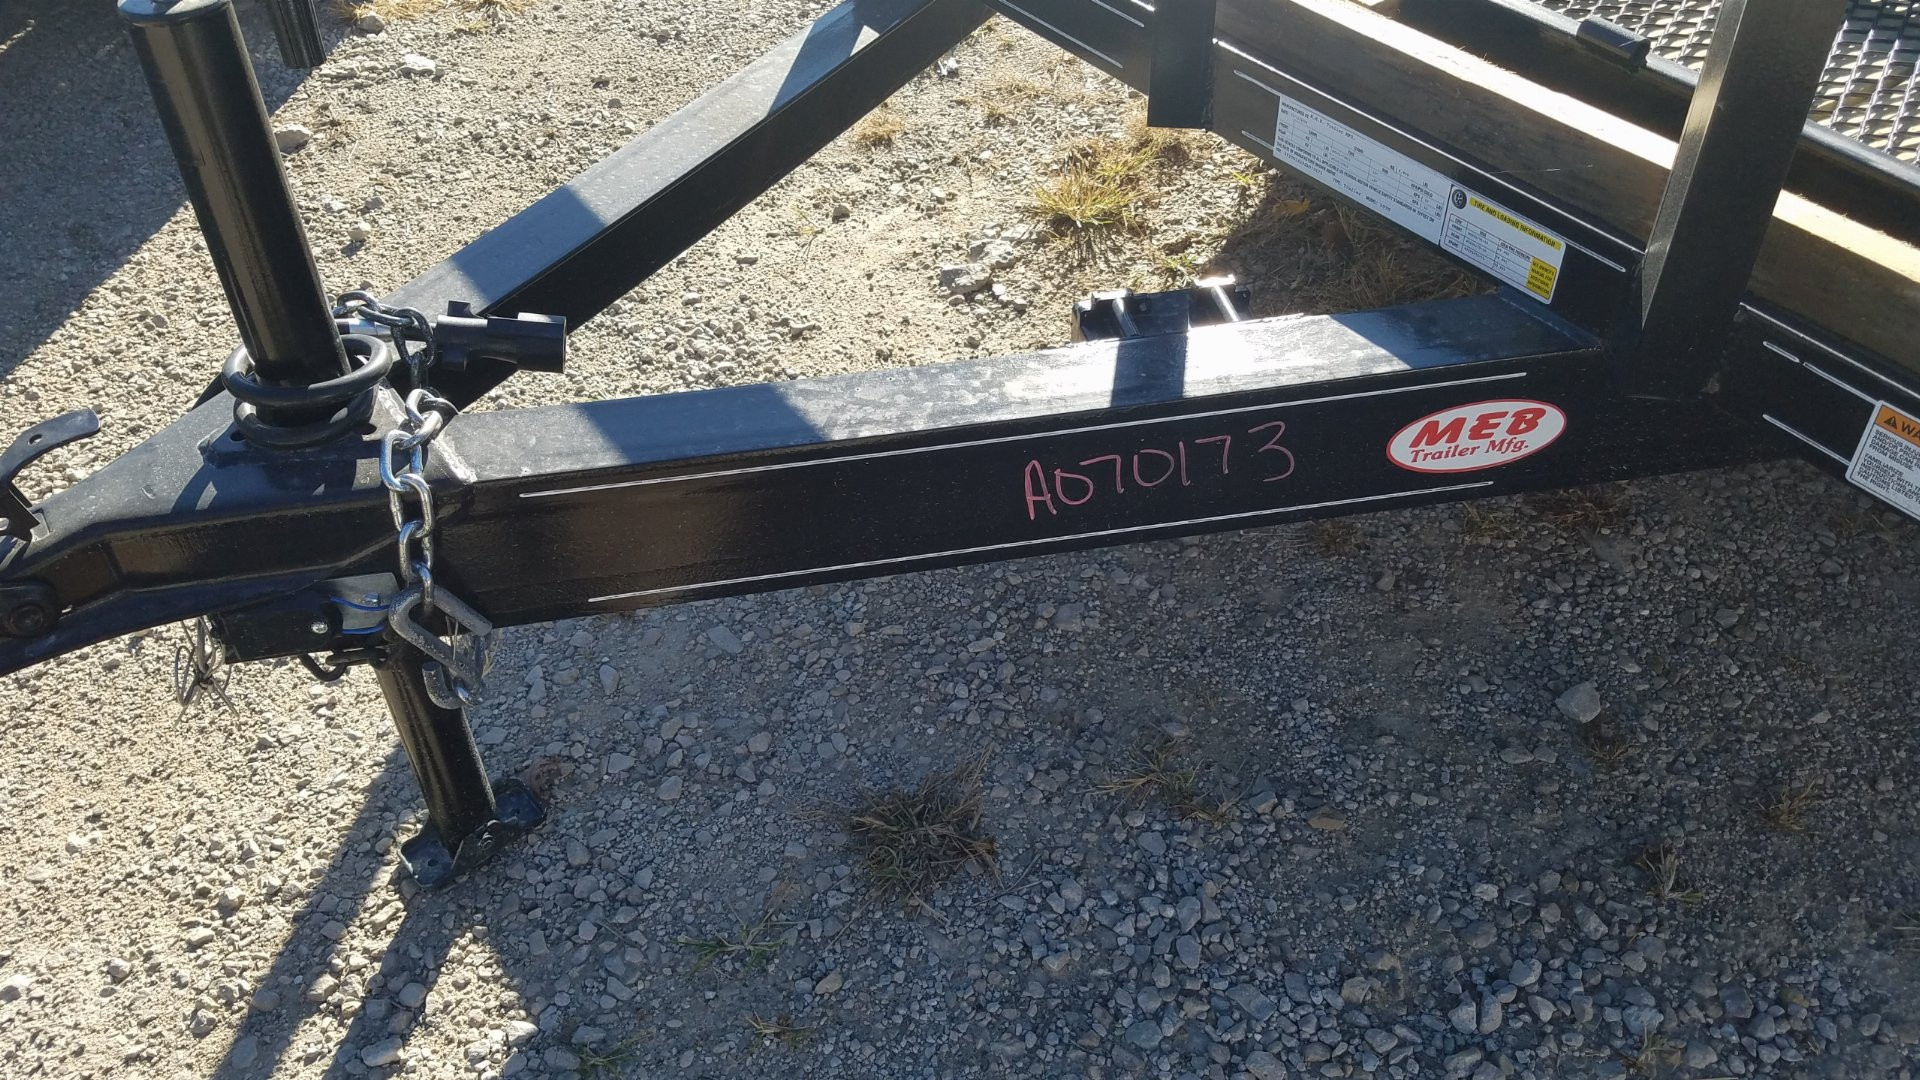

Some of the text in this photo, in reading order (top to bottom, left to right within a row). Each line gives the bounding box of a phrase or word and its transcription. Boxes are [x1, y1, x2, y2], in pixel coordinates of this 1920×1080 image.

[1473, 200, 1556, 248] TIRE AND LOADING INFORMATION
[1409, 407, 1547, 448] MEB
[1874, 430, 1904, 448] SERIOUS
[1410, 437, 1529, 463] Trailer Mfg.
[1868, 444, 1888, 457] FROM
[1870, 439, 1900, 457] DAMAGE
[1899, 454, 1914, 465] CAN
[1872, 434, 1899, 451] AND/OR
[1860, 462, 1908, 491] INSTRUCTIONS
[1862, 458, 1896, 479] YOURSELF
[1896, 476, 1914, 489] WITH
[1864, 453, 1904, 478] FAMILIARIZE
[1856, 471, 1891, 494] THE RIGHT.
[1858, 467, 1892, 488] CAUTIONS
[1890, 484, 1915, 500] LISTED
